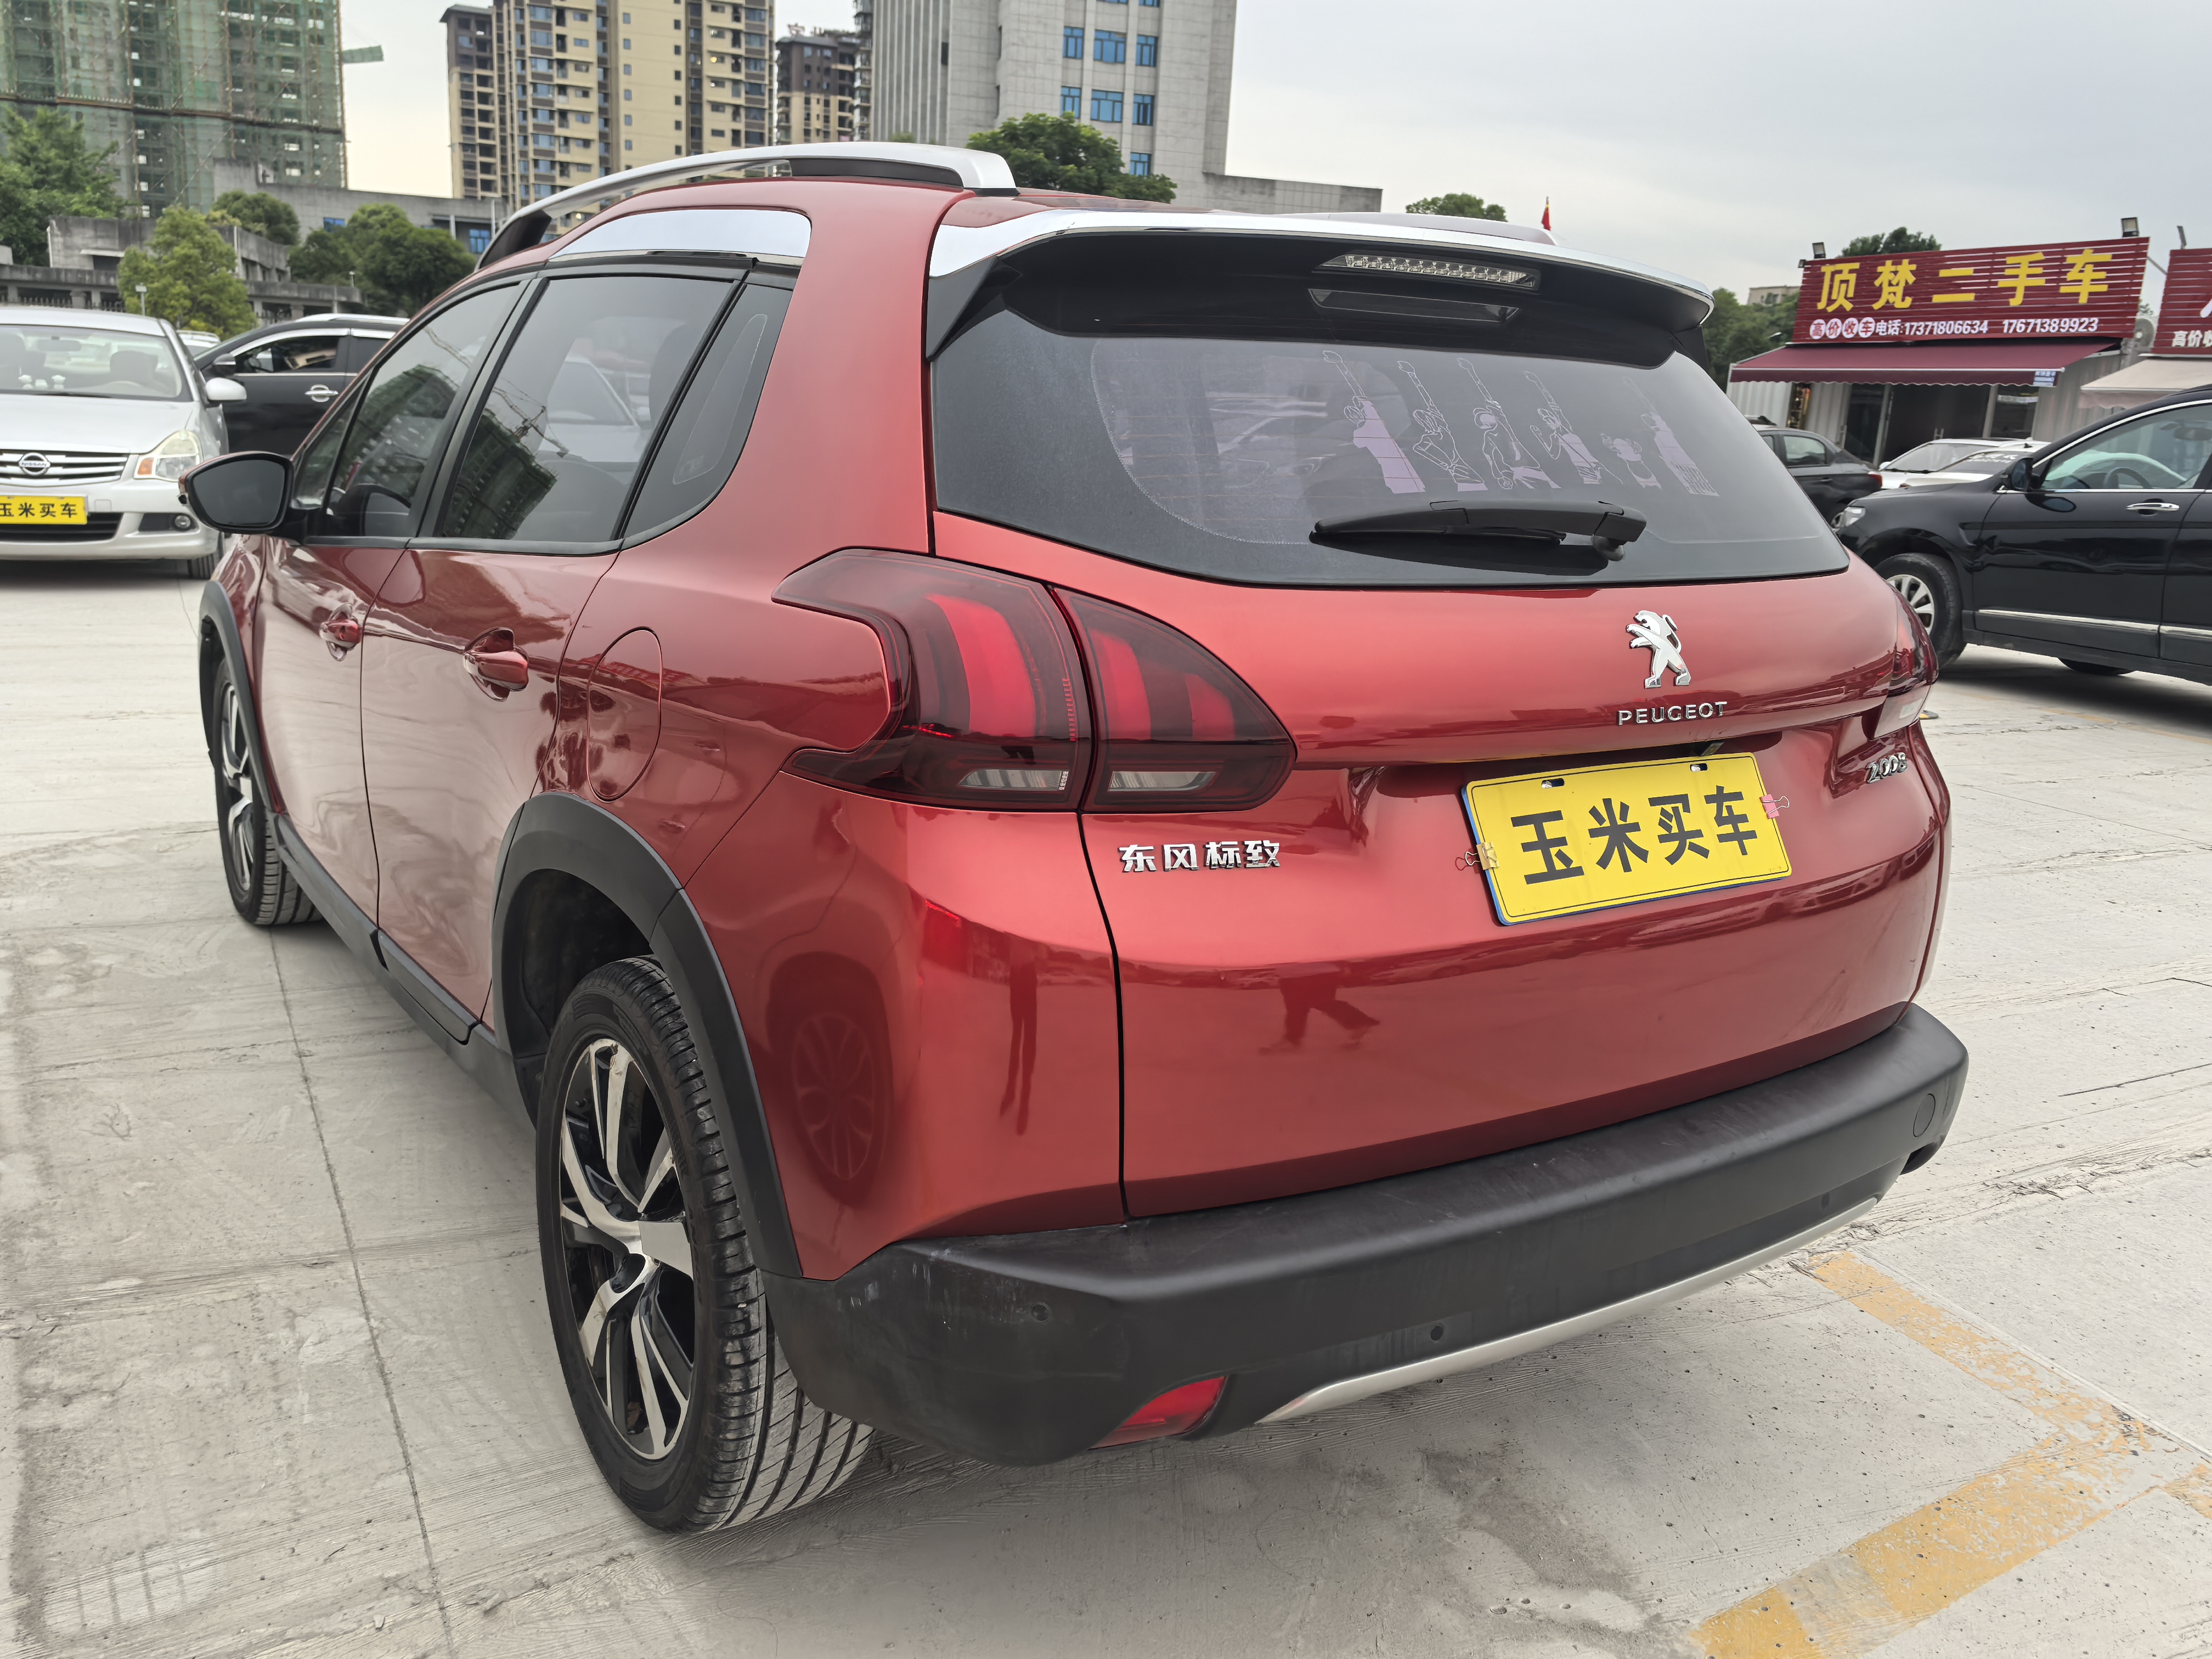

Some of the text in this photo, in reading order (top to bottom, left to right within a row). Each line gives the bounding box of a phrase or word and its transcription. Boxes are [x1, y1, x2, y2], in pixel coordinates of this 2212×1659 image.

[1817, 248, 2112, 312] 顶梵二手车
[2002, 318, 2099, 333] 17671389923
[0, 502, 77, 518] 玉米买车
[1617, 701, 1728, 726] PEUGEOT
[1866, 752, 1907, 784] 2008
[1510, 785, 1758, 885] 玉米买车
[1118, 840, 1280, 873] 东风标致
